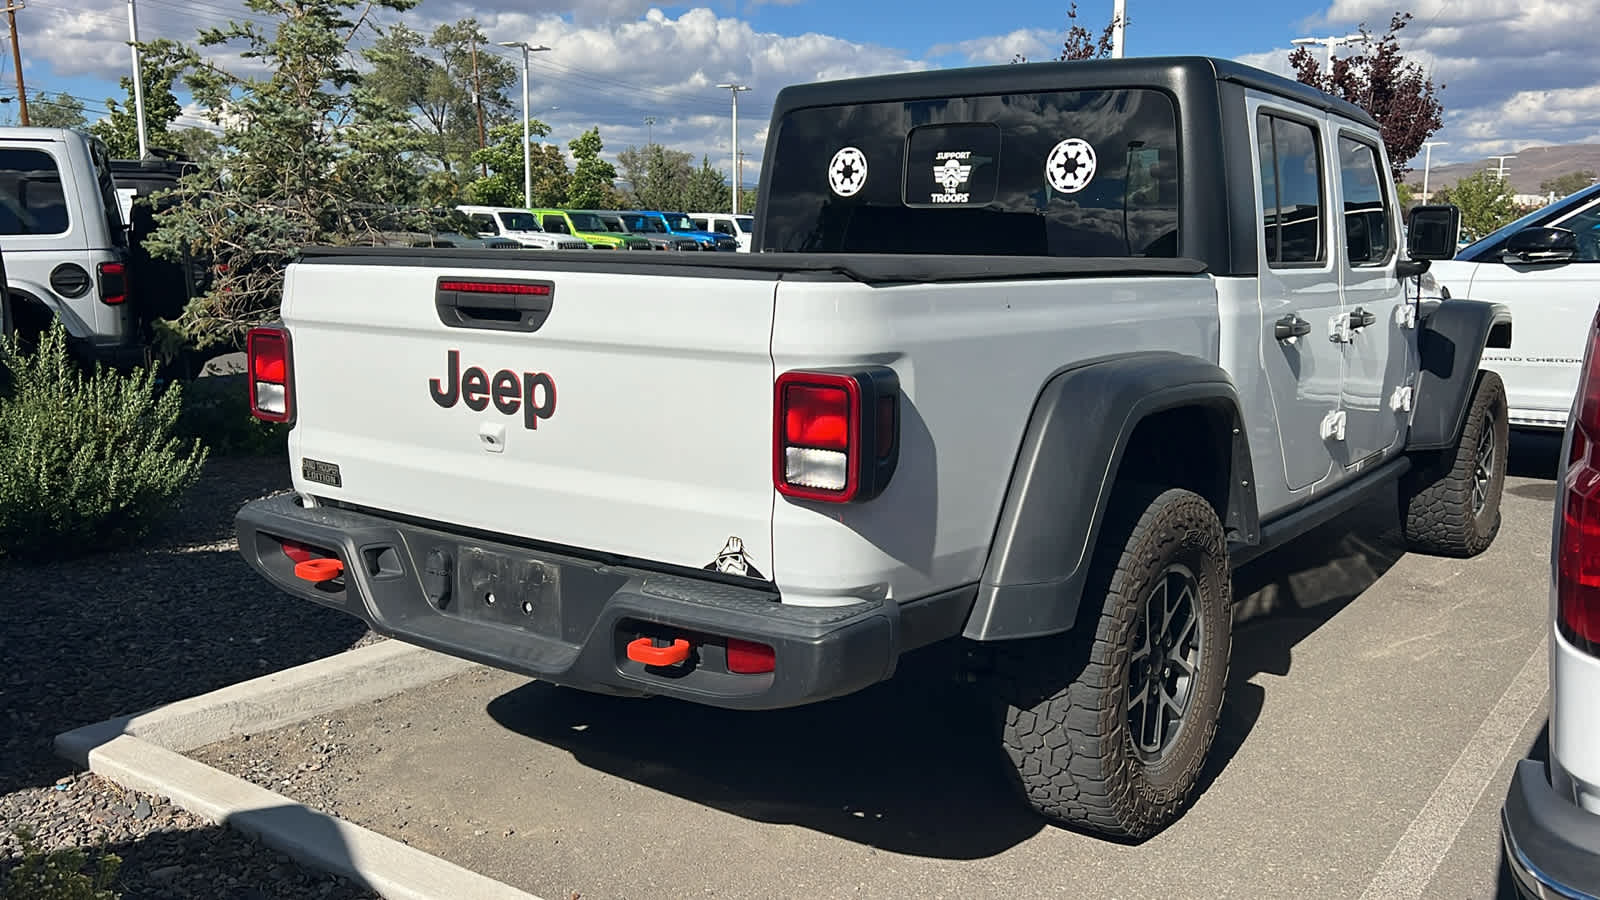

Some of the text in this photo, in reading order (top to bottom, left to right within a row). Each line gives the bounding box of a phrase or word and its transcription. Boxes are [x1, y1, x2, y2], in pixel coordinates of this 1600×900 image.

[936, 151, 971, 160] SUPPORT
[931, 192, 970, 203] TROOPS
[429, 349, 557, 430] Jeep
